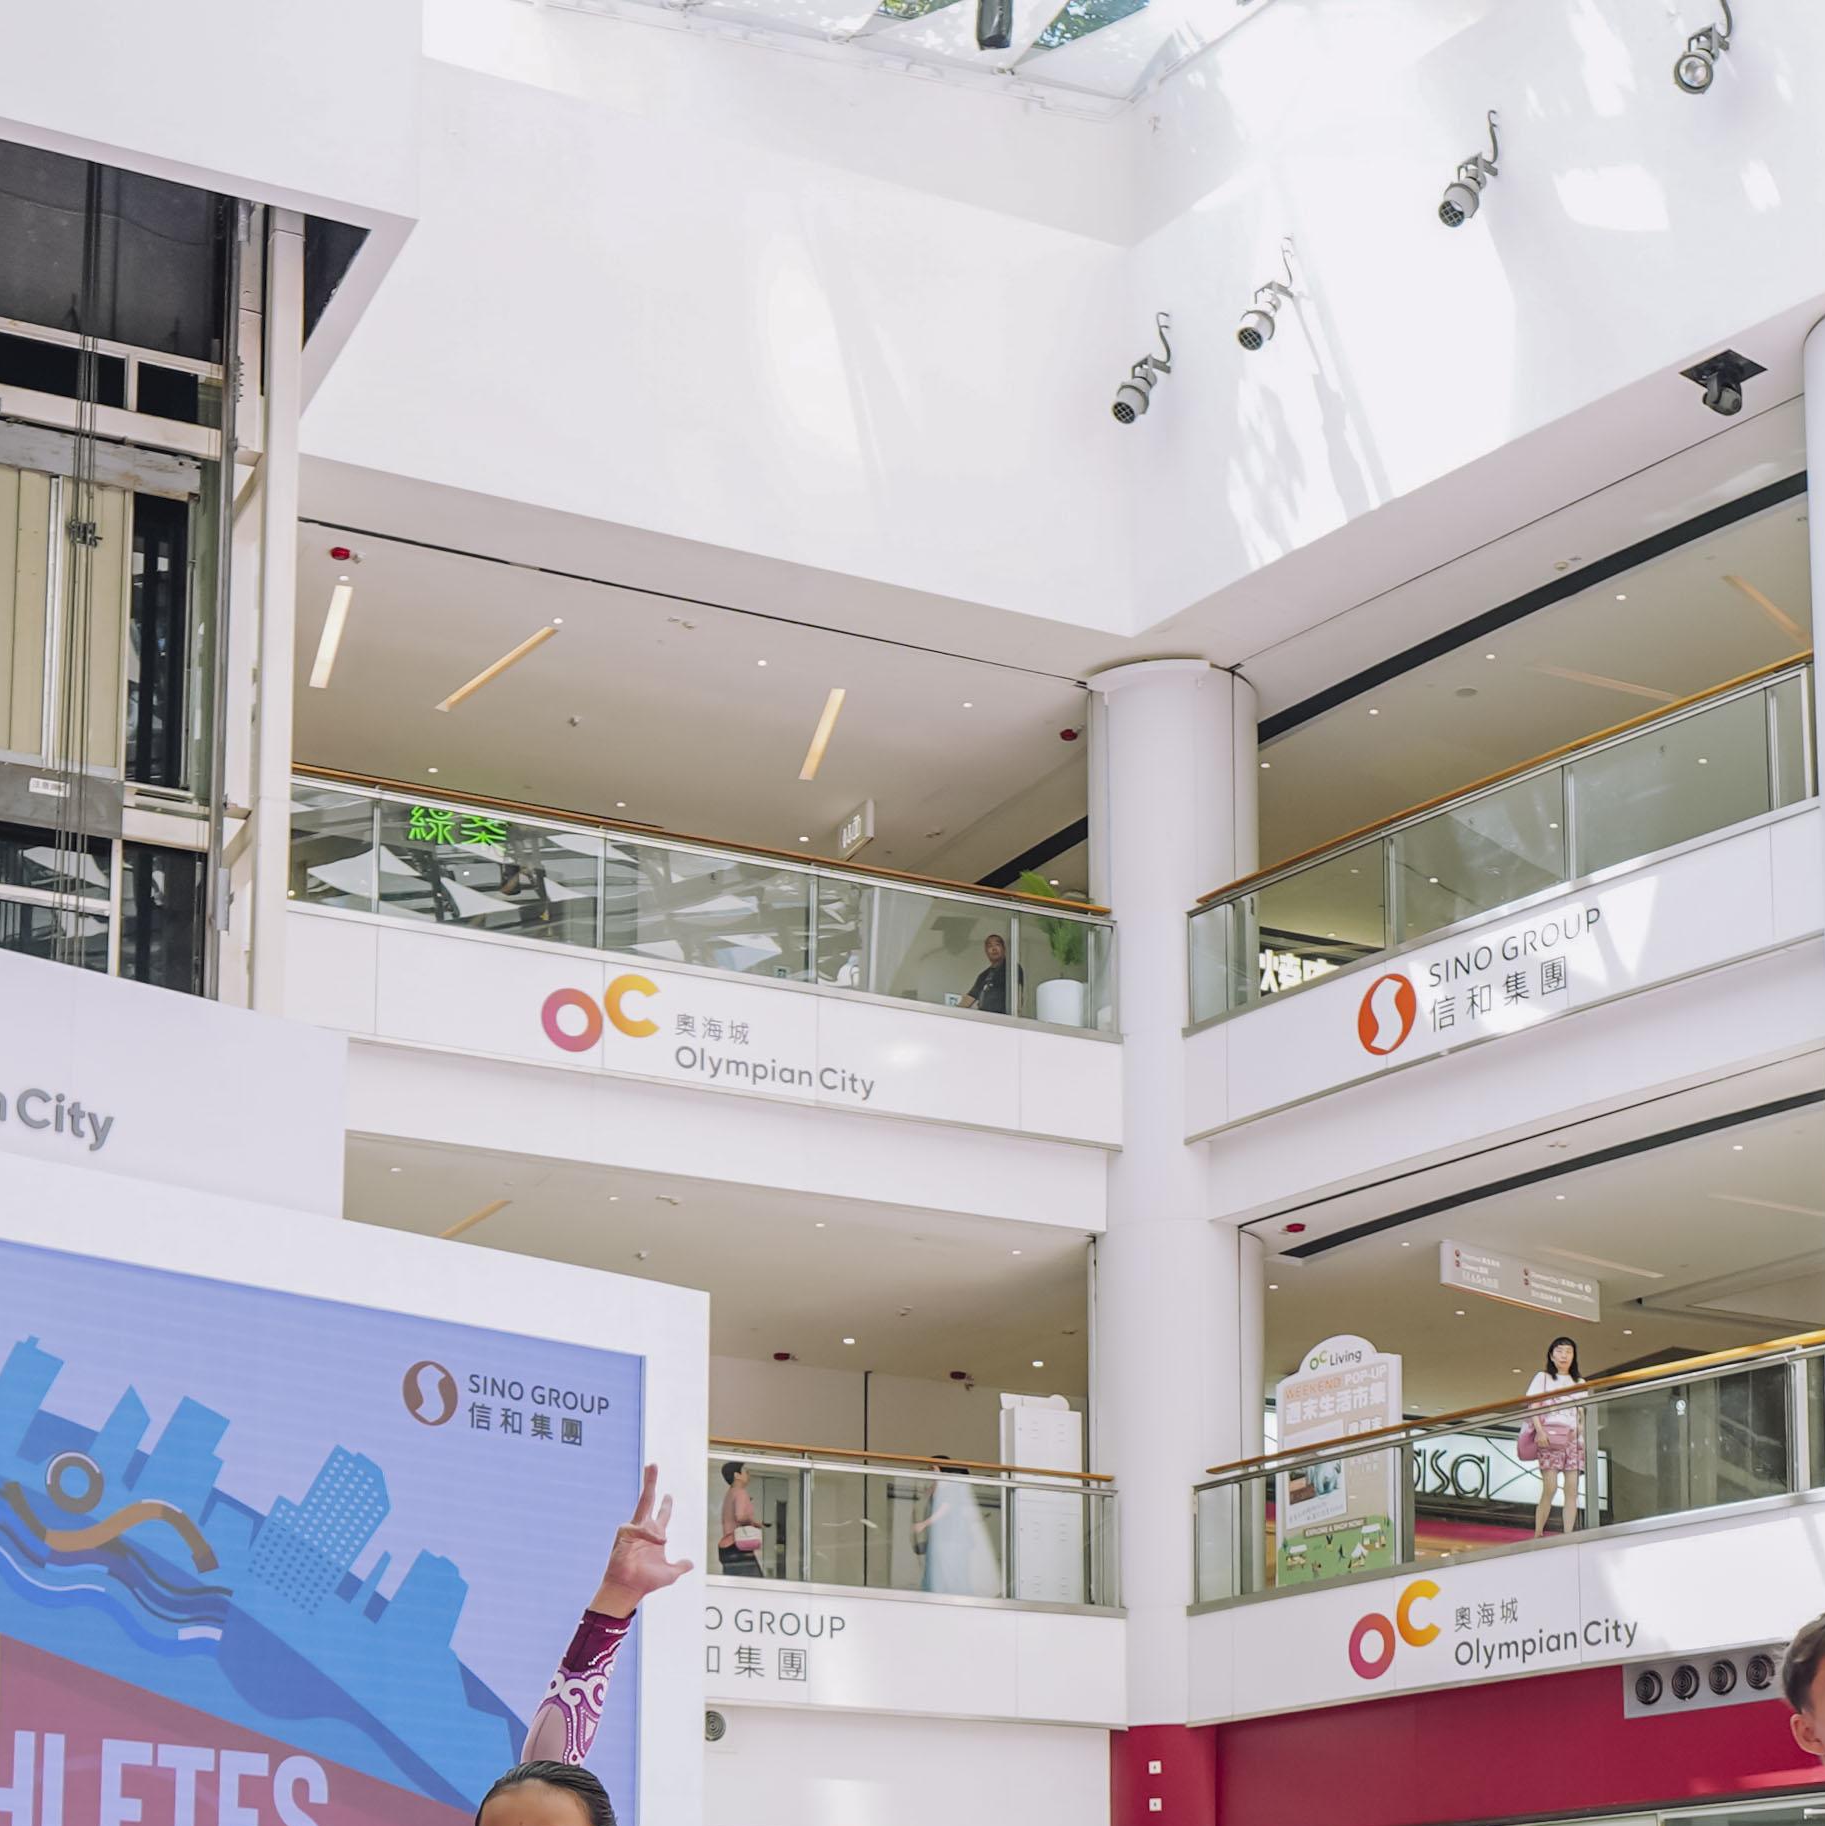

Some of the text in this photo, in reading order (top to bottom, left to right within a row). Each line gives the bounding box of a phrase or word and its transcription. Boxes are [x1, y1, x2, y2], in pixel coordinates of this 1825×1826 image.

[1428, 907, 1601, 988] SINO GROUP
[1429, 956, 1567, 1033] 信和集團
[675, 1013, 750, 1045] 奧海城
[675, 1046, 875, 1101] Olympian City
[17, 1088, 115, 1152] City
[1330, 1350, 1362, 1366] Living
[468, 1374, 610, 1416] SINO GROUP
[1285, 1375, 1342, 1399] WEEKEND
[468, 1402, 583, 1447] 信和集團
[734, 1608, 847, 1640] GROUP
[1454, 1597, 1519, 1633] 奧海城
[1455, 1619, 1638, 1668] Olympian City
